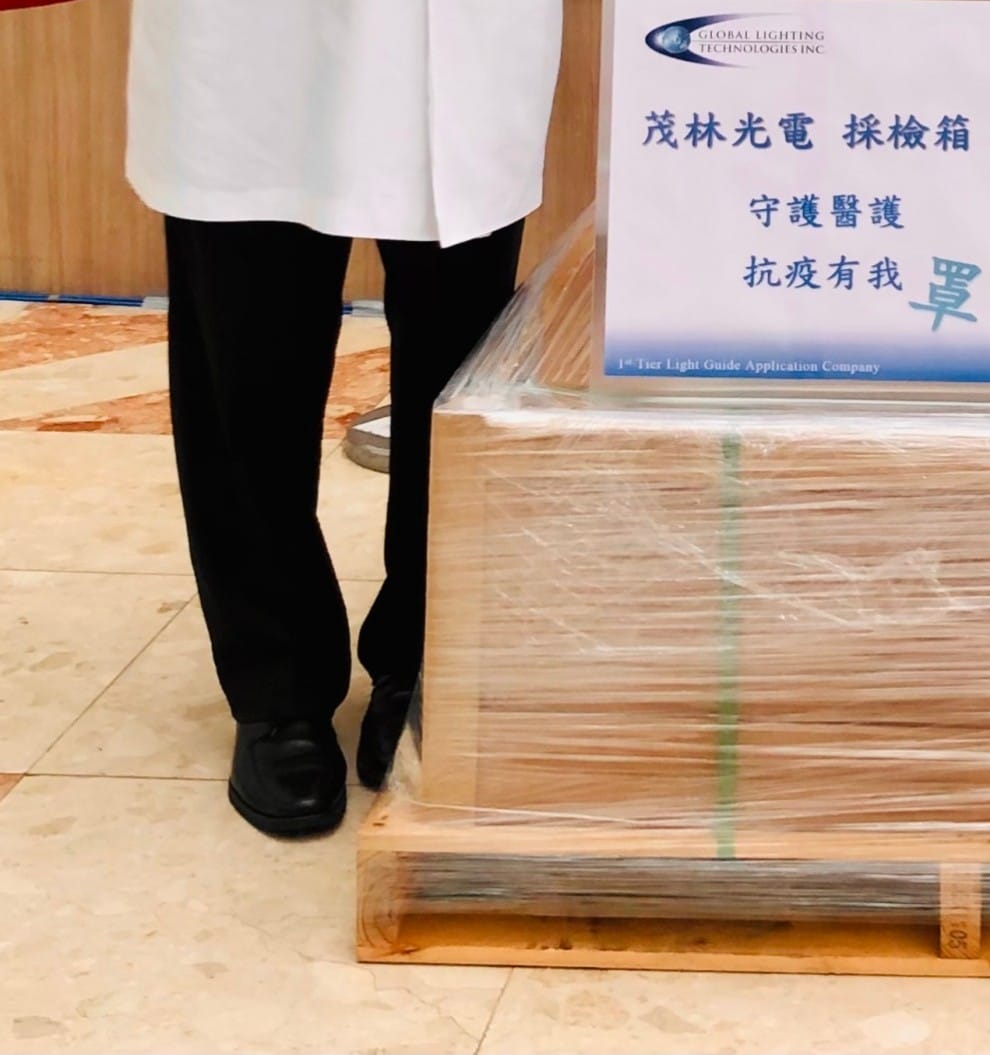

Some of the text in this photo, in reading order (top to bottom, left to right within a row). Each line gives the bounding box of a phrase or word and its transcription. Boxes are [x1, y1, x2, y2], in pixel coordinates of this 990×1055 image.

[698, 29, 825, 42] GLOBAL LIGHTING
[699, 43, 798, 56] TECHNOLOGIES
[642, 109, 971, 151] 茂林光電 採檢箱
[749, 193, 905, 229] 守護醫護
[637, 359, 662, 370] Tier
[666, 358, 700, 372] Light
[704, 359, 741, 372] Guide
[745, 359, 818, 374] Application
[822, 360, 880, 375] Company
